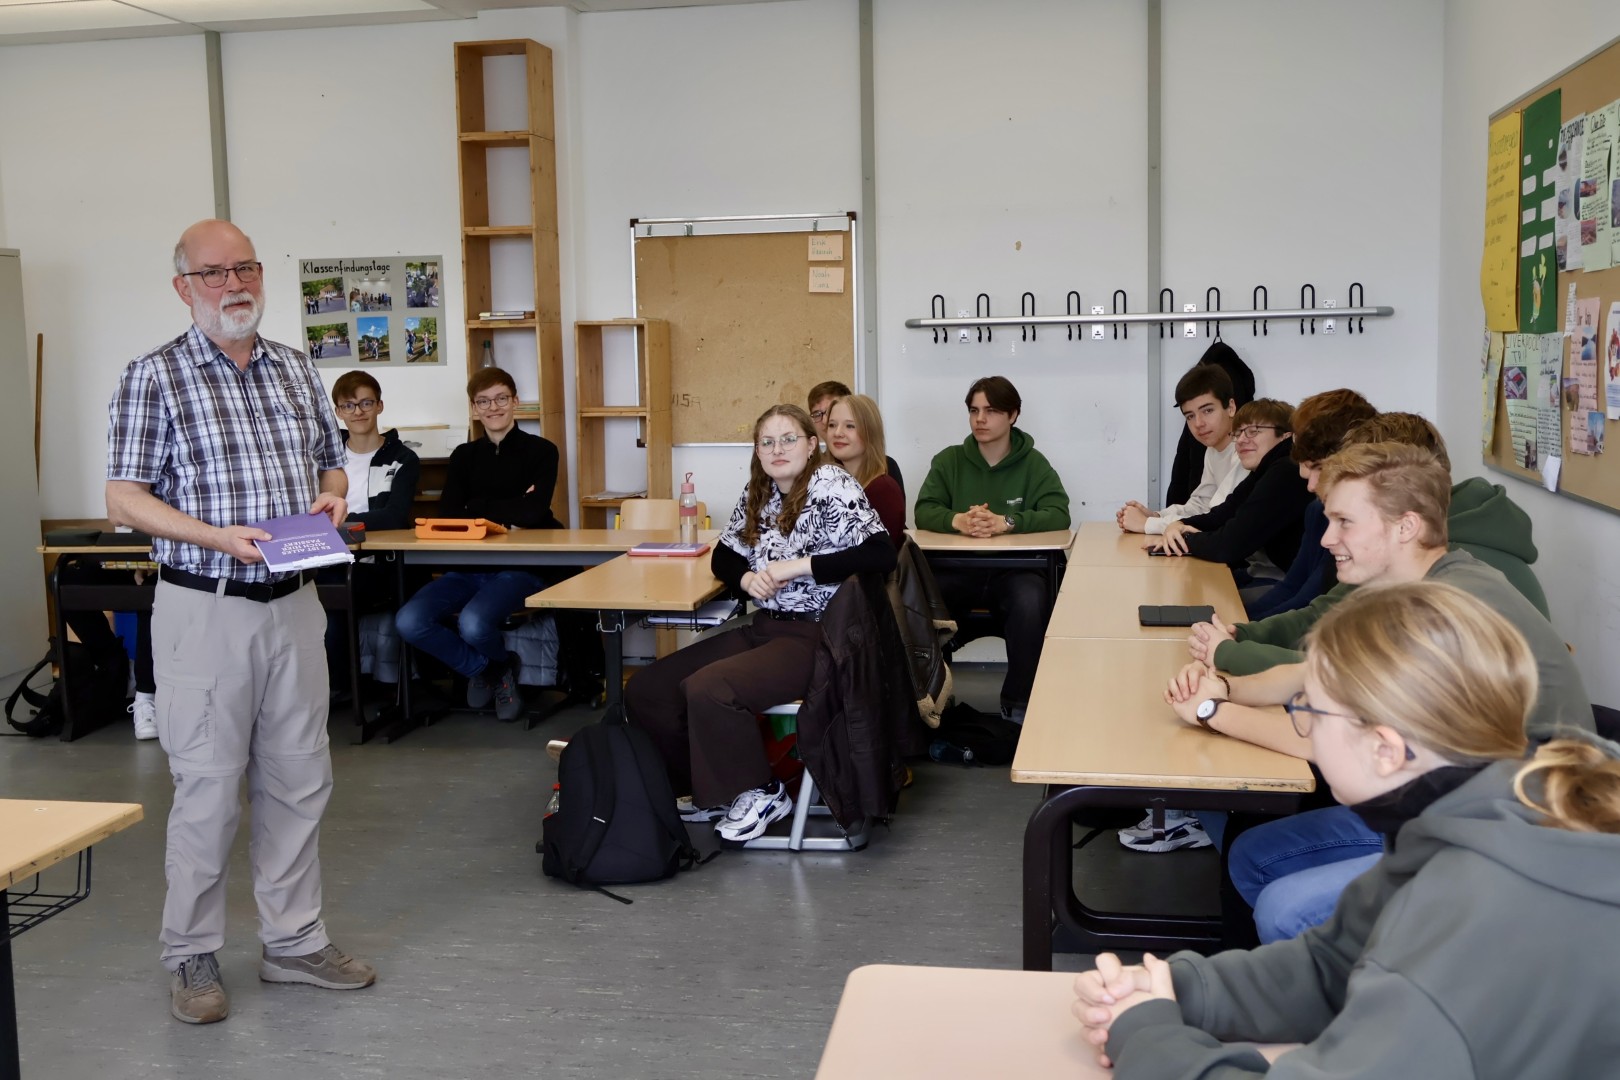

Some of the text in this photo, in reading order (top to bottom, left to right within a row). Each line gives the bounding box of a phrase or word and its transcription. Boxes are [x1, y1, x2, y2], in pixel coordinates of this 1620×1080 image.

[303, 259, 391, 276] Klassenfindungstage
[1505, 334, 1540, 352] LIVERPOOL
[283, 538, 321, 547] PASSIERT
